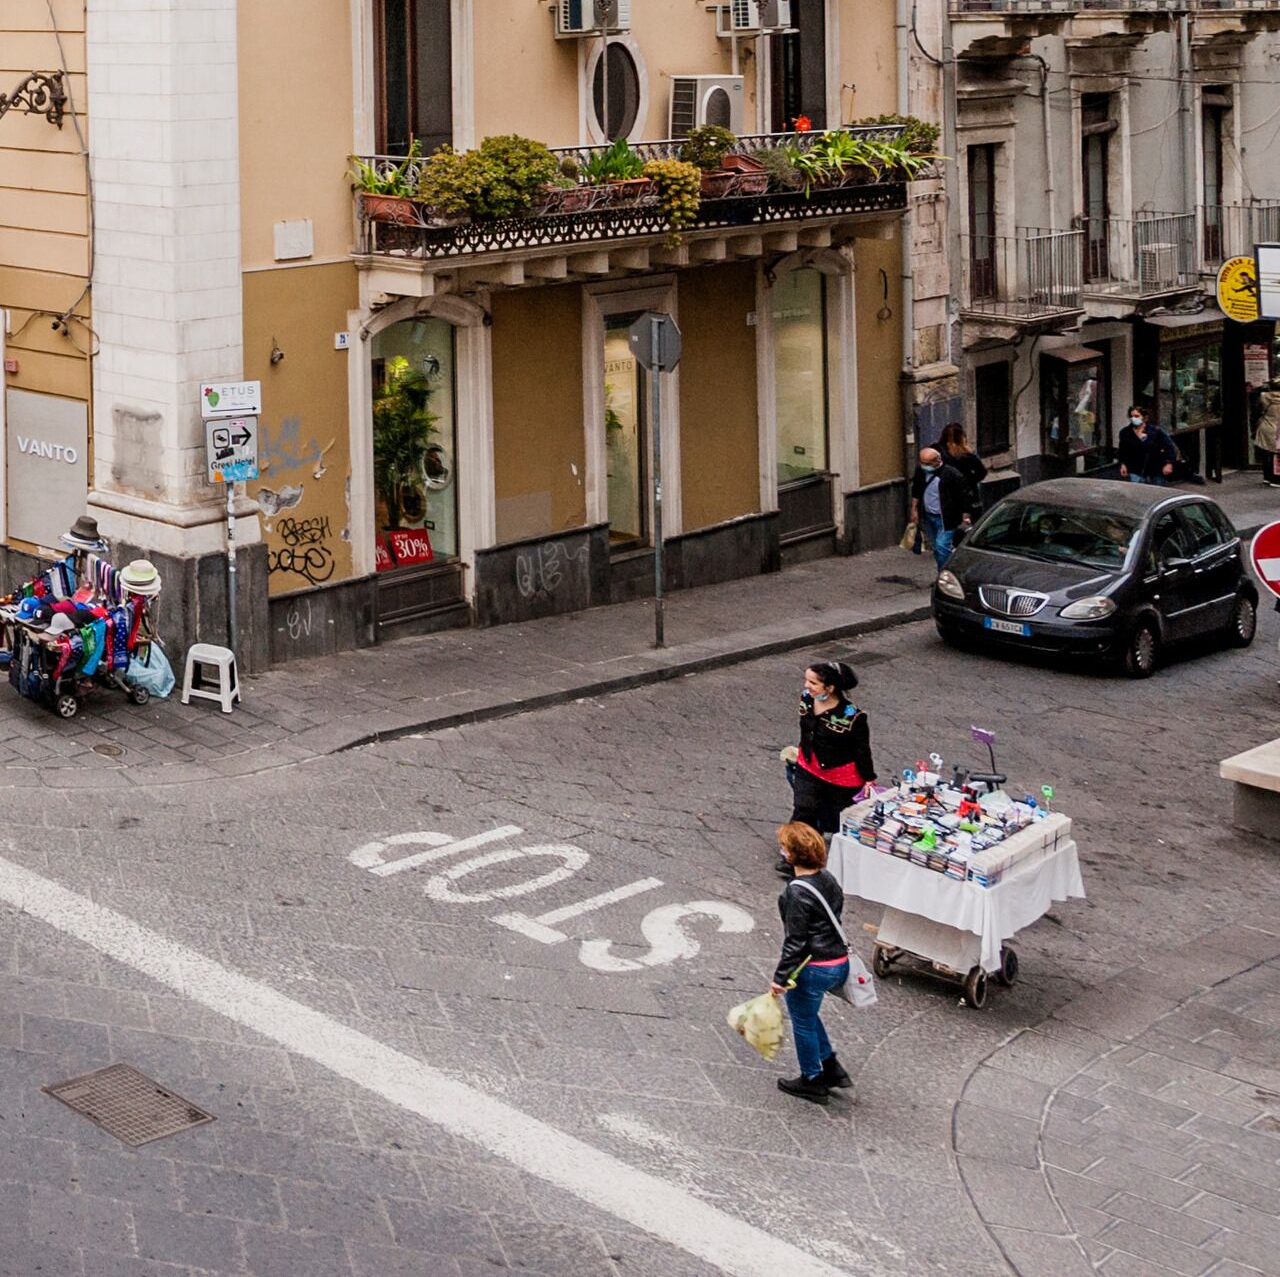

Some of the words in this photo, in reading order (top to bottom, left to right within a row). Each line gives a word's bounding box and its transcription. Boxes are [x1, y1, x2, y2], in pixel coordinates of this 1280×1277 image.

[221, 385, 255, 397] ETUS
[16, 435, 78, 464] VANTO
[395, 538, 428, 559] 30%
[347, 824, 756, 972] STOP
